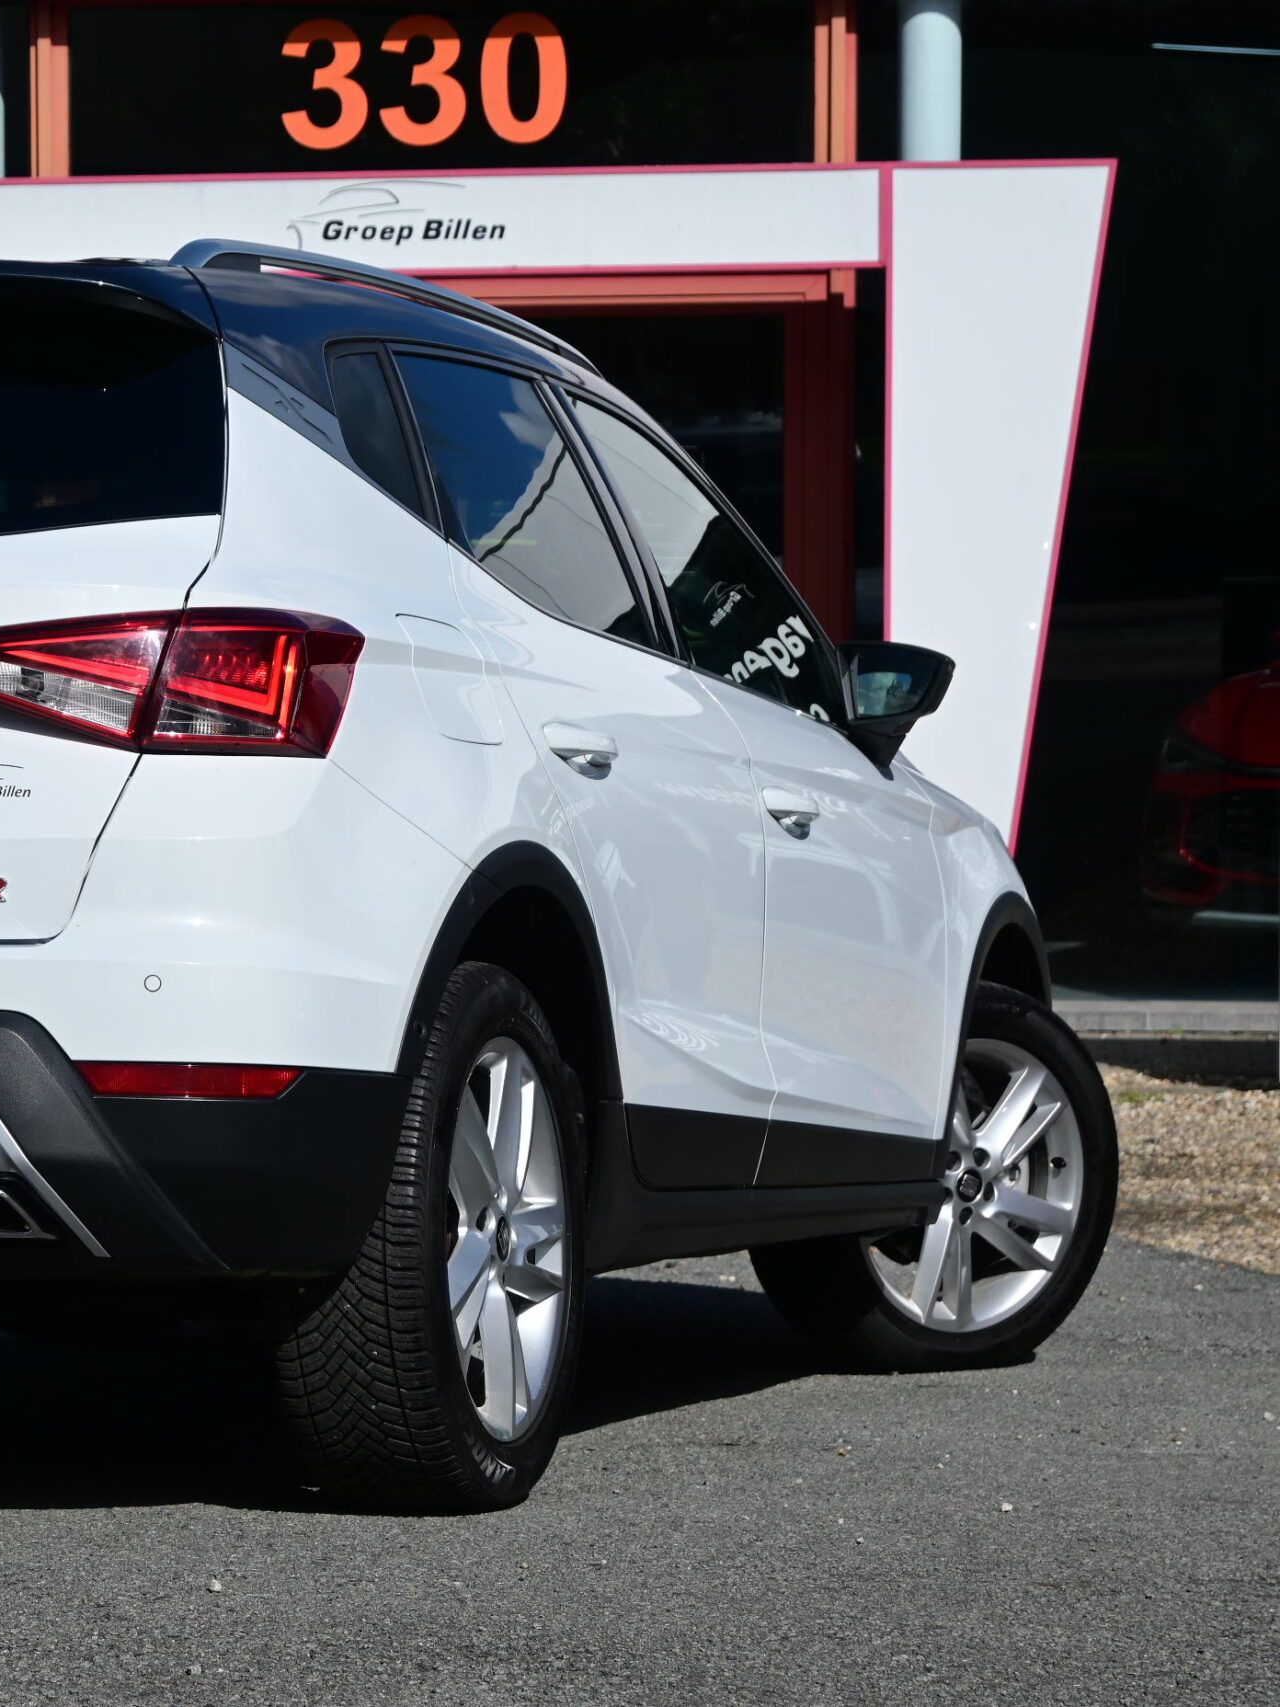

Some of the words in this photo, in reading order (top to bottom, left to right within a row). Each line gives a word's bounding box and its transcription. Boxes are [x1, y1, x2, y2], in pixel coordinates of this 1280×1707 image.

[281, 11, 568, 150] 330
[321, 219, 414, 246] Groep
[422, 217, 506, 241] Billen
